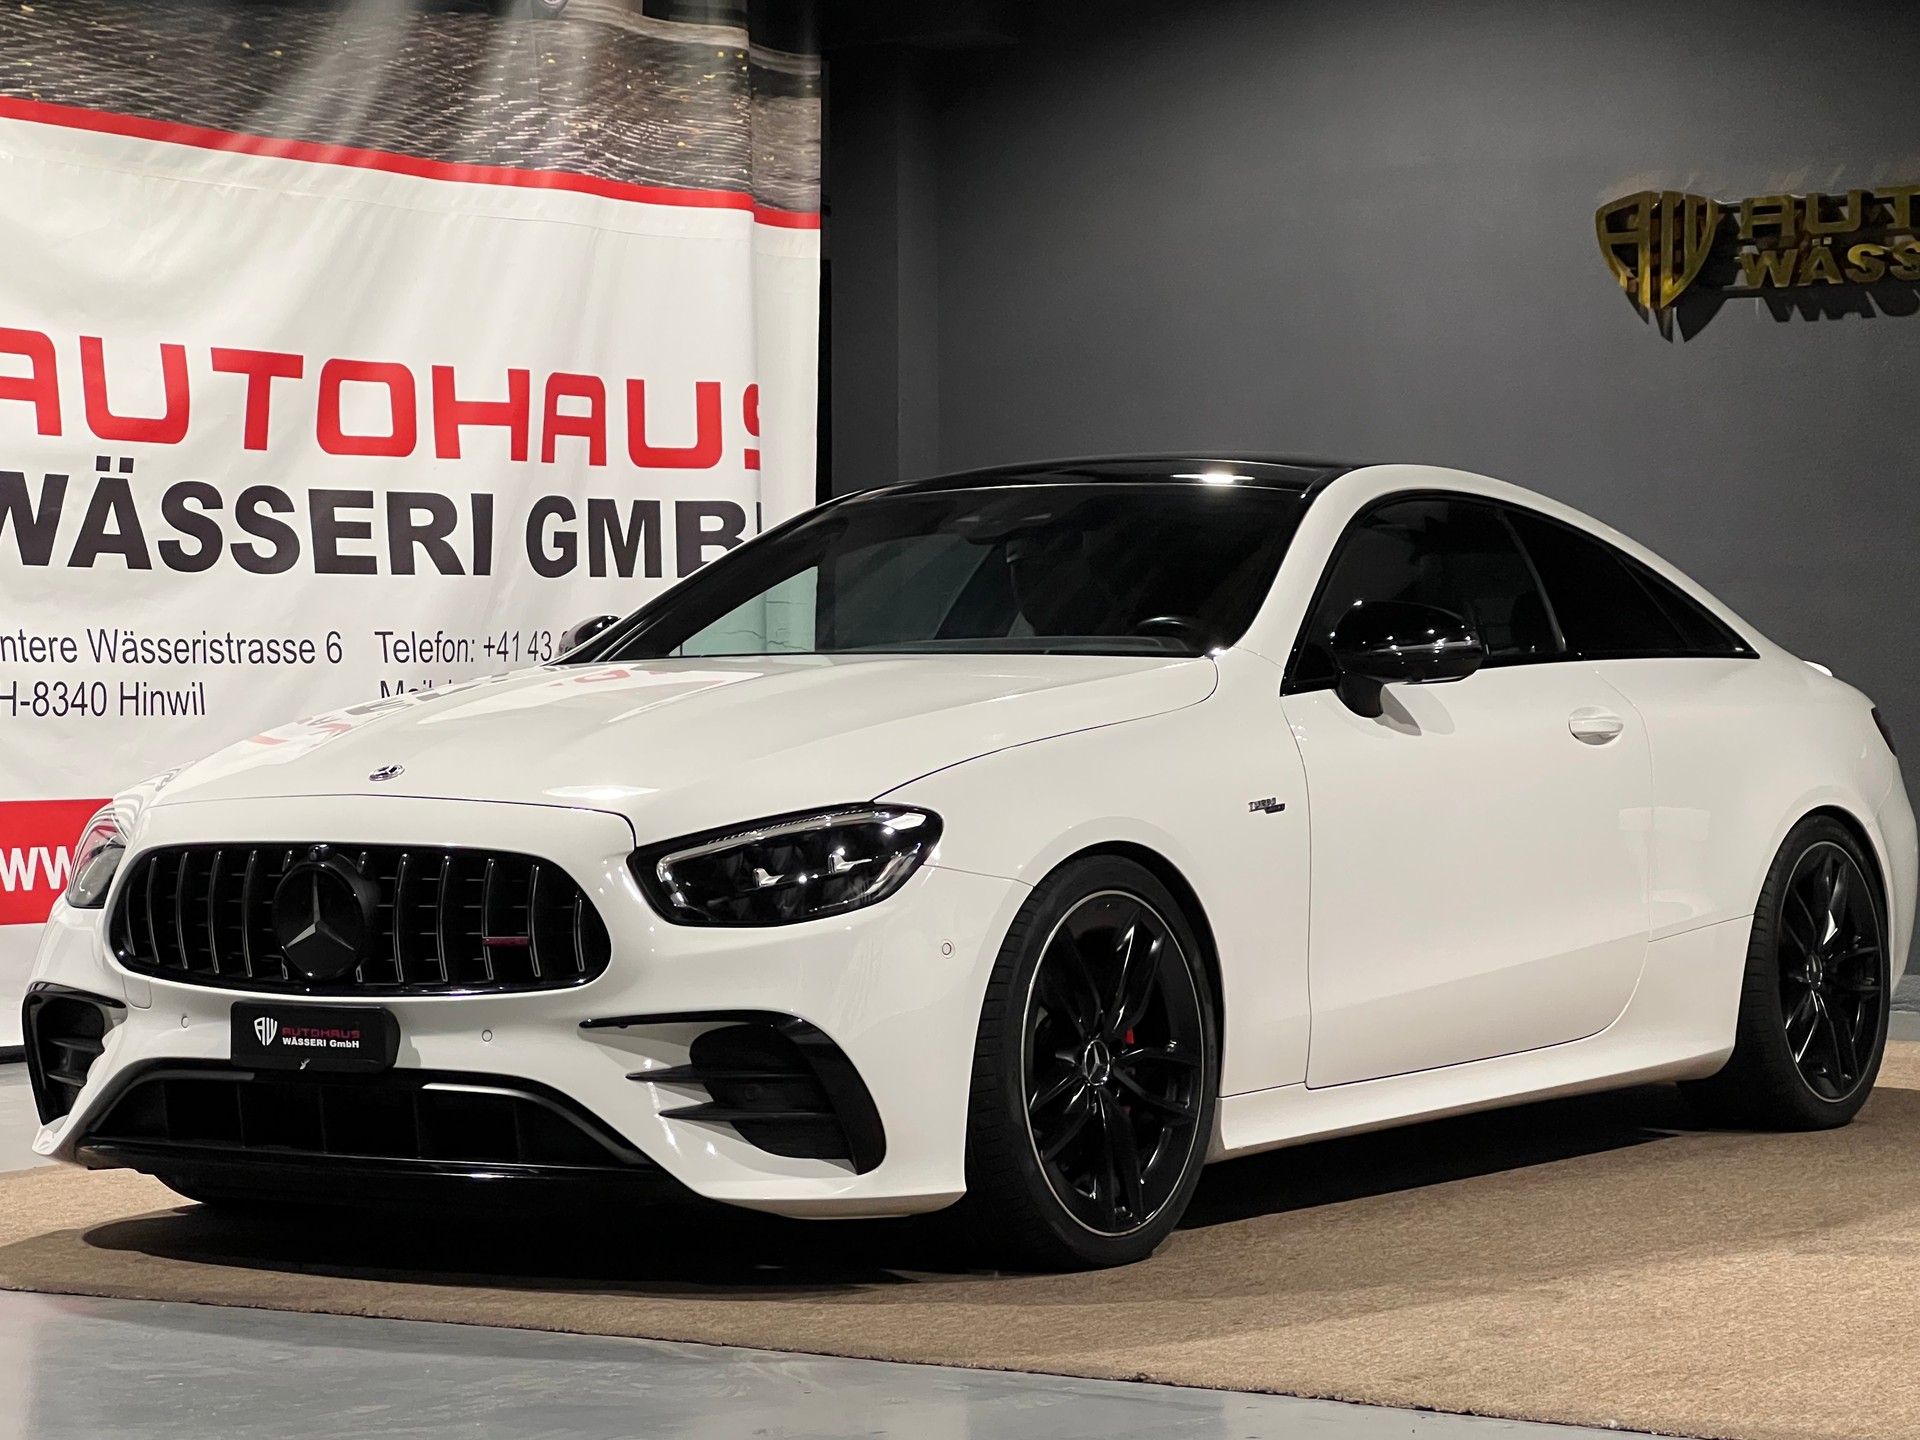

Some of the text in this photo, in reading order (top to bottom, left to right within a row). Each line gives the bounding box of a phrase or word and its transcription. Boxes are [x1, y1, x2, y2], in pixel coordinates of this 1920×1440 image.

[1740, 185, 1920, 240] AUT
[1739, 237, 1920, 288] WÄSS
[0, 327, 761, 471] AUTOHAU
[0, 455, 762, 579] WÄSSERI GMB
[87, 628, 316, 664] Wässeristrasse
[325, 630, 343, 663] 6
[374, 630, 475, 664] Telefon:
[483, 630, 520, 663] +41
[527, 630, 552, 662] 43
[119, 680, 206, 717] Hinwil
[281, 1027, 361, 1039] AUTOHAUS
[282, 1036, 360, 1048] WÄSSERI GmbH
